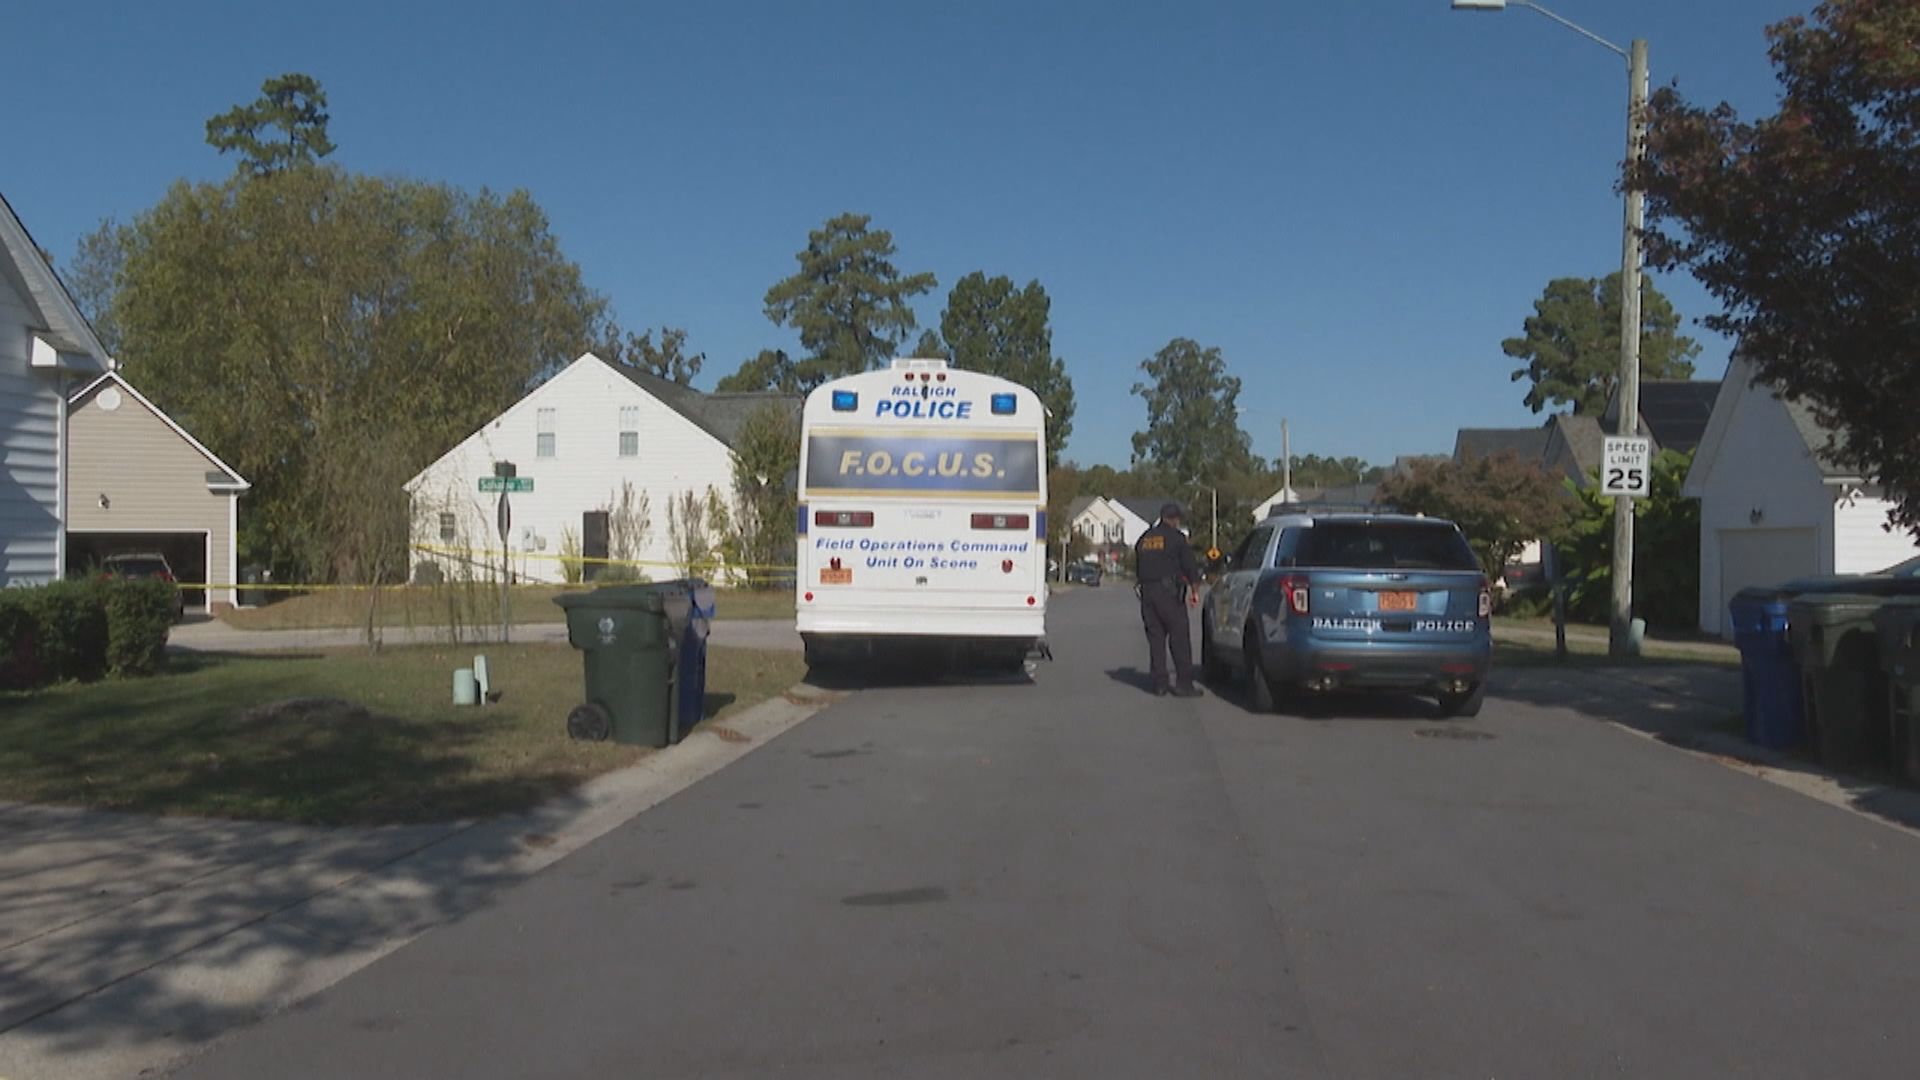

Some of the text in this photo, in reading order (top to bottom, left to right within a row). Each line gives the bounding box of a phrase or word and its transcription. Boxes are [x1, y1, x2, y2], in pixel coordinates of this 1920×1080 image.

[891, 385, 957, 397] RALIGH
[875, 399, 973, 419] POLICE
[1607, 441, 1647, 453] SPEED
[839, 450, 1006, 479] F.O.C.U.S.
[1610, 454, 1642, 465] LIMIT
[1607, 468, 1644, 490] 25
[816, 537, 1029, 553] Field Operations Command
[866, 556, 978, 570] Unit On Scene
[1312, 617, 1475, 632] RALEIGH POLICE
